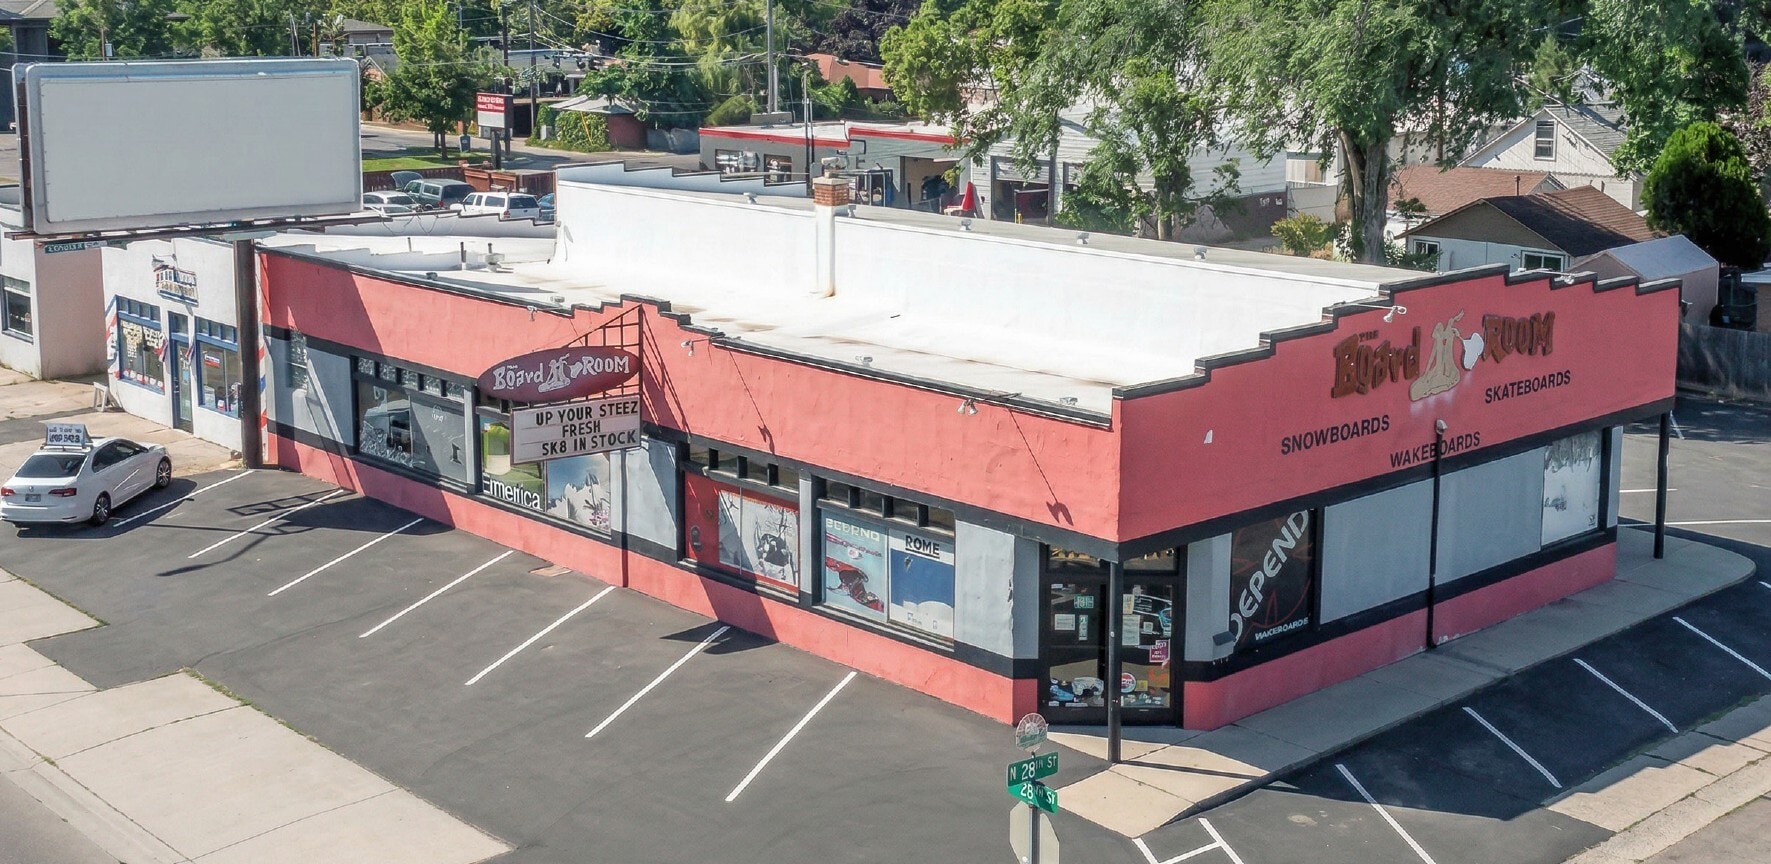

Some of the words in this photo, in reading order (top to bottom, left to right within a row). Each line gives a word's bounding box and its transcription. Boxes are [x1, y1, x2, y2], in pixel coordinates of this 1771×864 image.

[1481, 310, 1555, 363] ROOM
[582, 354, 630, 376] ROOM
[1485, 370, 1571, 404] SKATEBOARDS
[535, 411, 553, 426] UP
[558, 406, 593, 423] YOUR
[599, 401, 638, 418] STEEZ
[562, 420, 601, 438] FRESH
[1281, 414, 1390, 455] SNOWBOARDS
[542, 440, 567, 456] SK8
[574, 437, 586, 451] IN
[591, 430, 637, 449] STOCK
[1390, 431, 1480, 468] WAKEBOARDS
[905, 534, 940, 555] ROME
[1010, 766, 1017, 782] N
[1047, 756, 1057, 769] ST
